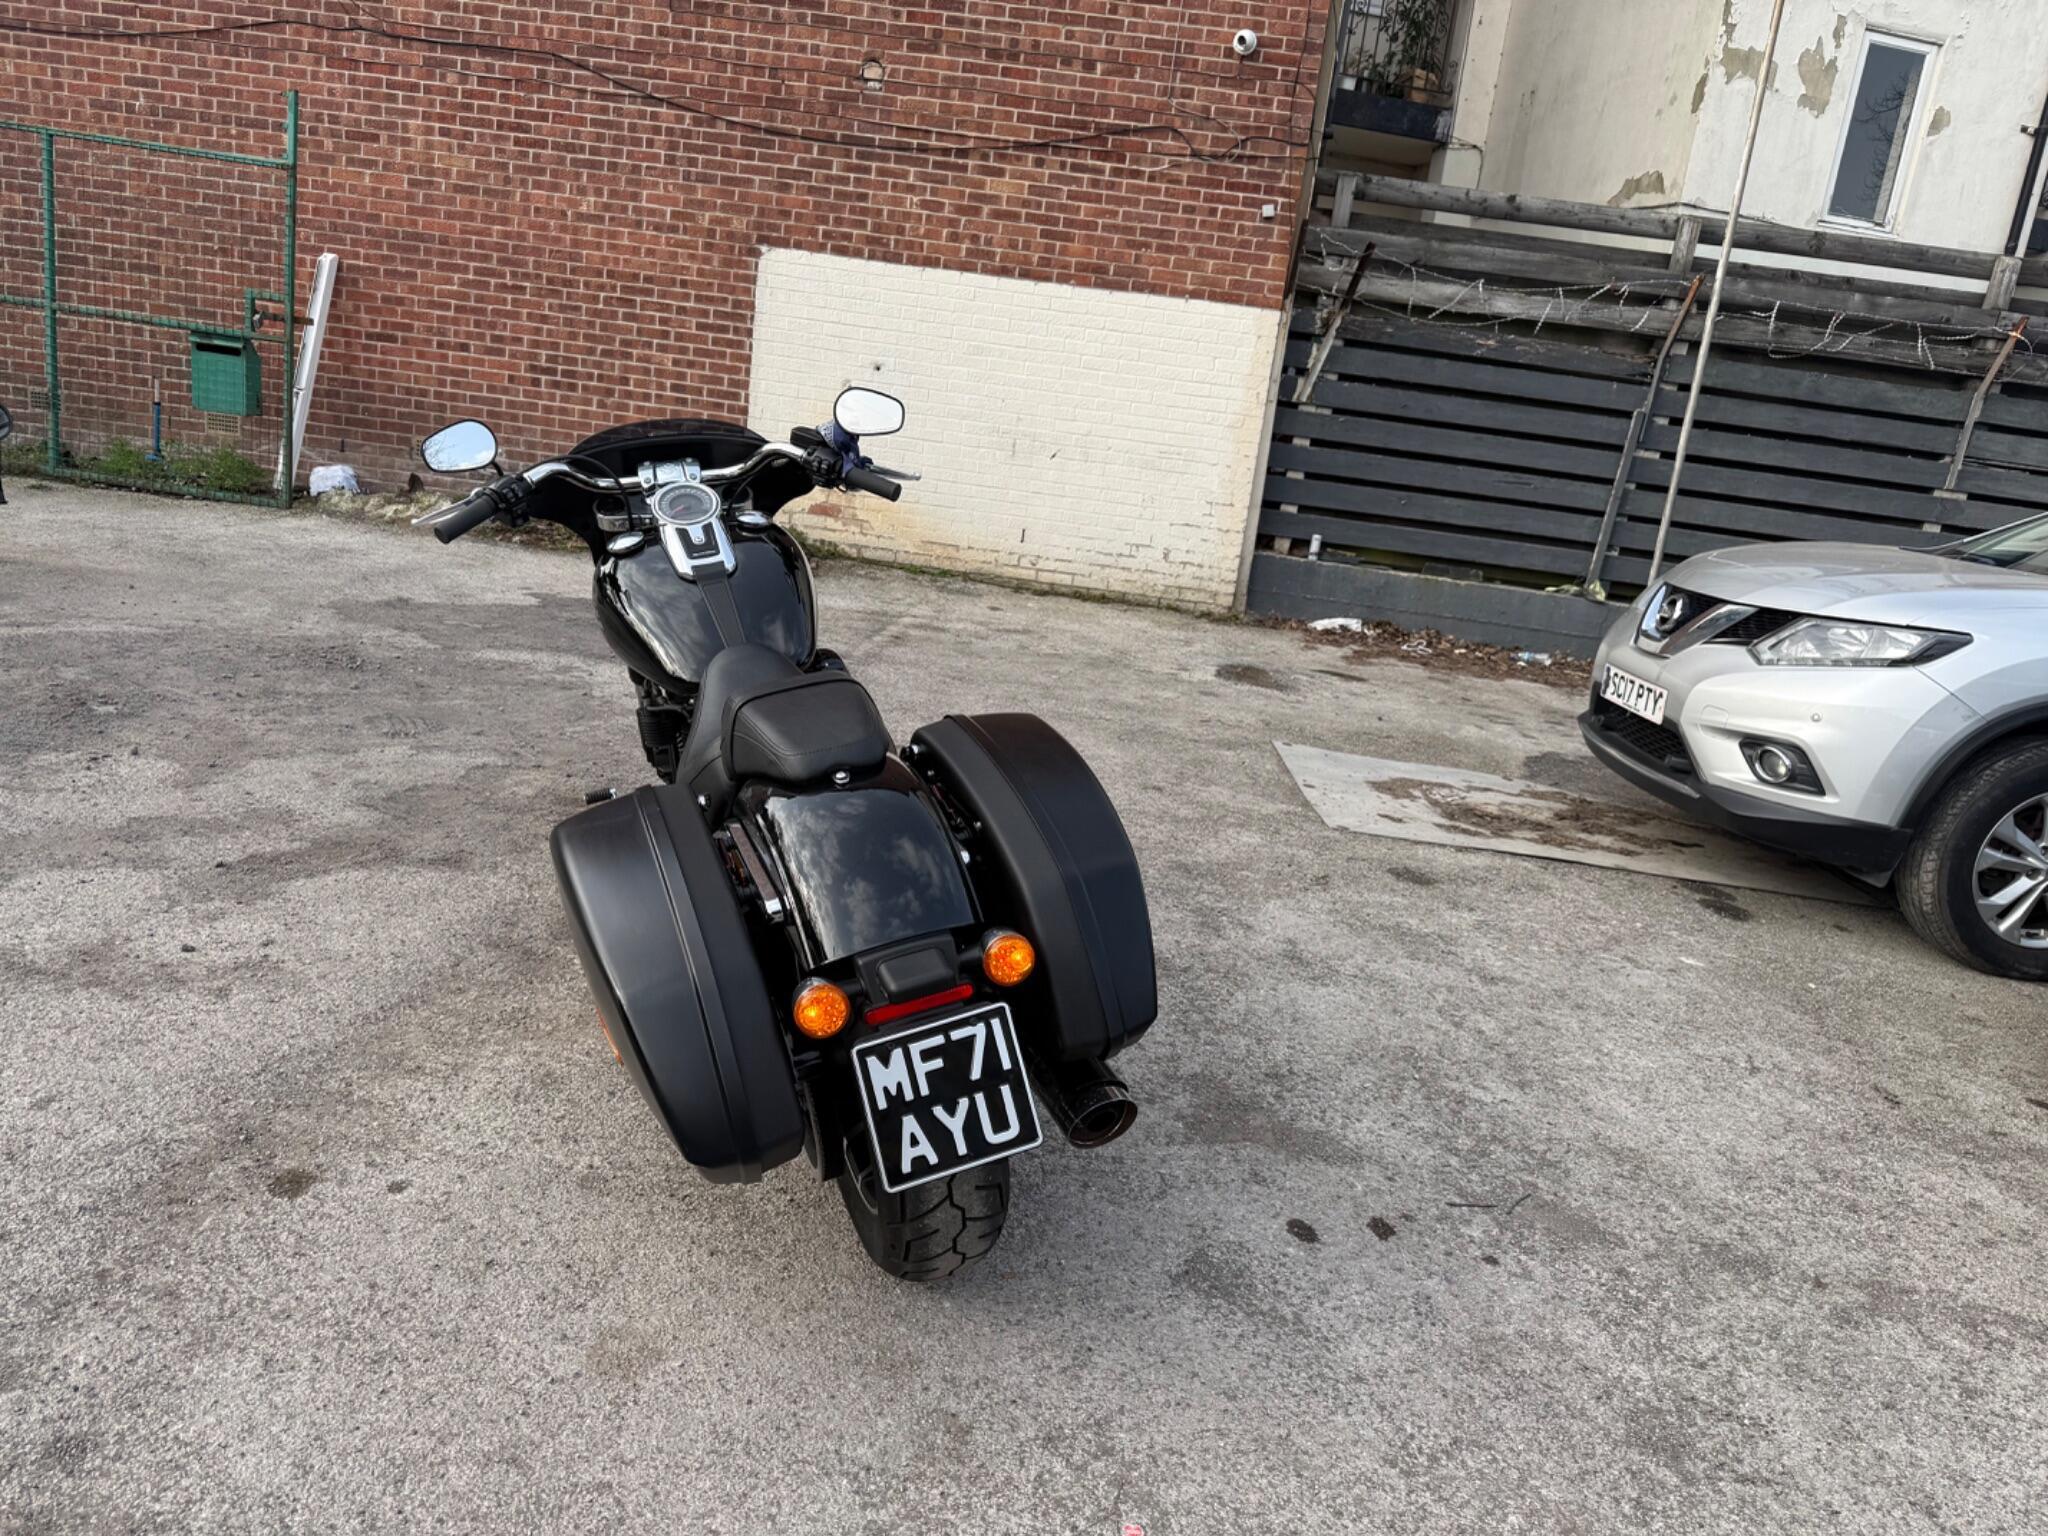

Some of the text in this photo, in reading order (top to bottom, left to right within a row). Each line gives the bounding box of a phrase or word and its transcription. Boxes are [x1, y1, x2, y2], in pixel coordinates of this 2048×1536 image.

[1611, 673, 1663, 715] SC17 PTY
[866, 1018, 1012, 1110] MF71
[901, 1085, 1020, 1174] AYU
